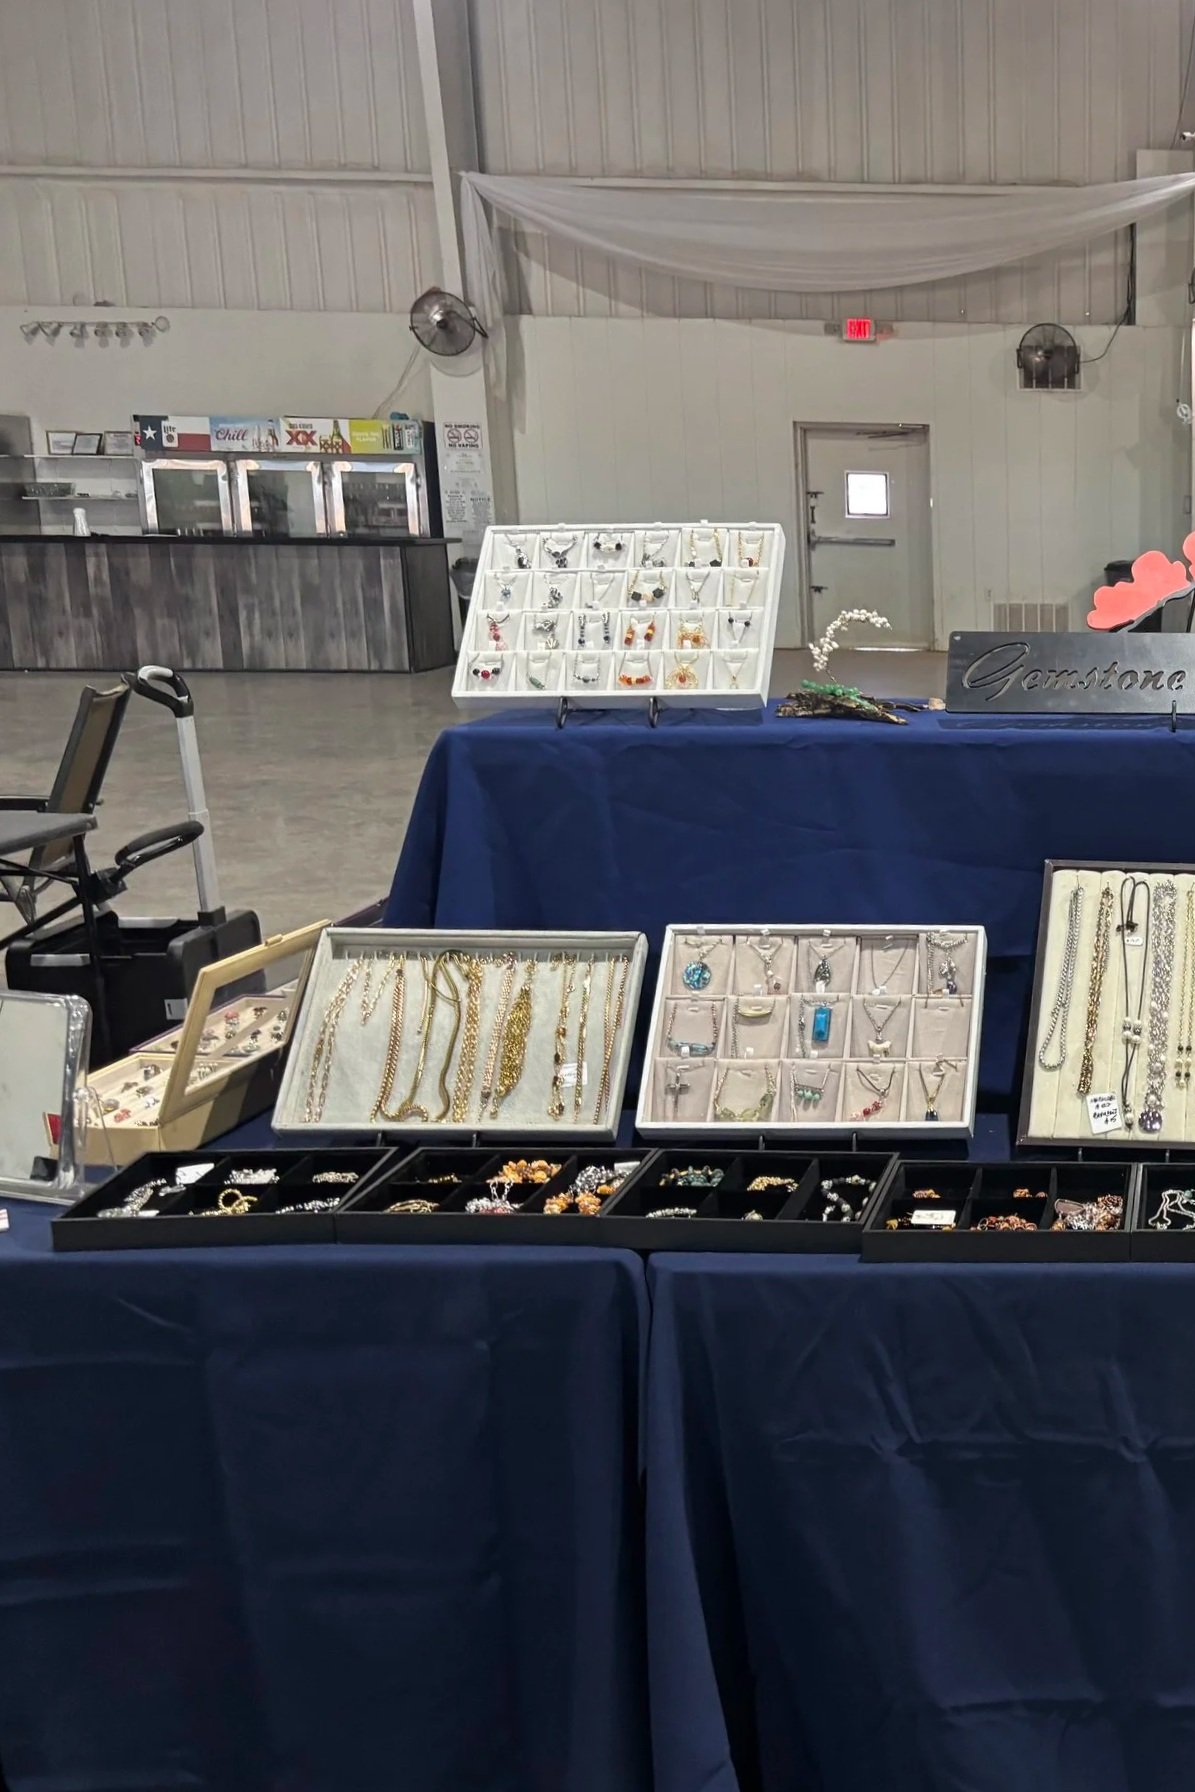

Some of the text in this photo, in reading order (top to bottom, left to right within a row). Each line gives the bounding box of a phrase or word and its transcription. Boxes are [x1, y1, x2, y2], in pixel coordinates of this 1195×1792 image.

[848, 320, 870, 338] EXIT
[215, 428, 249, 441] Chill
[285, 430, 319, 446] XX
[962, 641, 1187, 701] Gemstone
